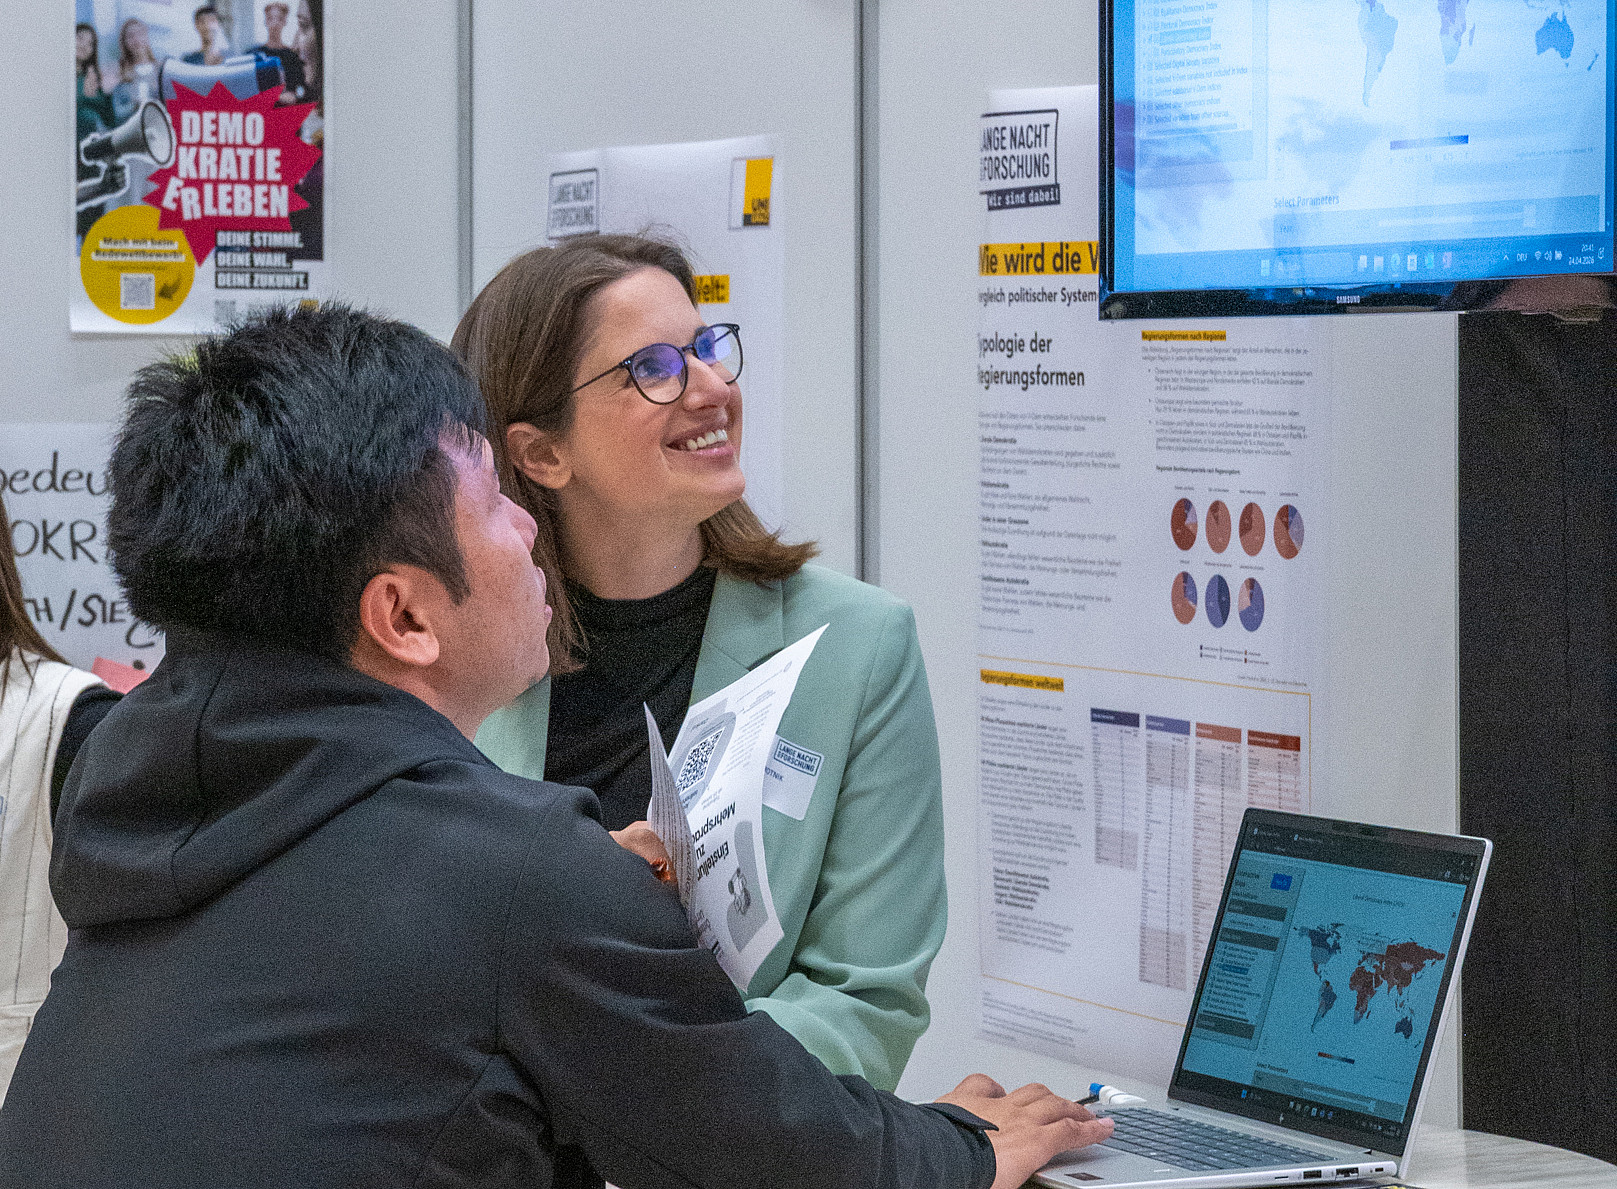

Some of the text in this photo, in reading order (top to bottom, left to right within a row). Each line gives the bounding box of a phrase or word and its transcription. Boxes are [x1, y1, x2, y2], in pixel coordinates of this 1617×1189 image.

[181, 110, 264, 146] DEMO
[981, 123, 1050, 152] ANGE NACHT
[178, 146, 281, 181] KRATIE
[984, 152, 1050, 180] FORSCHUNG
[162, 176, 289, 221] ERLEBEN
[1005, 190, 1026, 206] sind
[1297, 195, 1340, 208] Parameters
[217, 231, 304, 248] DEINE STIMME.
[217, 252, 291, 268] DEINE WAHL.
[1004, 242, 1044, 273] wird
[1052, 242, 1081, 272] die
[217, 273, 307, 288] DEINE ZUKUNFT.
[979, 287, 1097, 307] rgleich politischer System
[1336, 295, 1360, 304] SAMSUNG
[978, 331, 1052, 358] ypologie der
[12, 519, 98, 563] OKR
[779, 743, 818, 766] LANGE NACHT
[764, 766, 784, 781] OTNIK
[696, 843, 706, 860] zu
